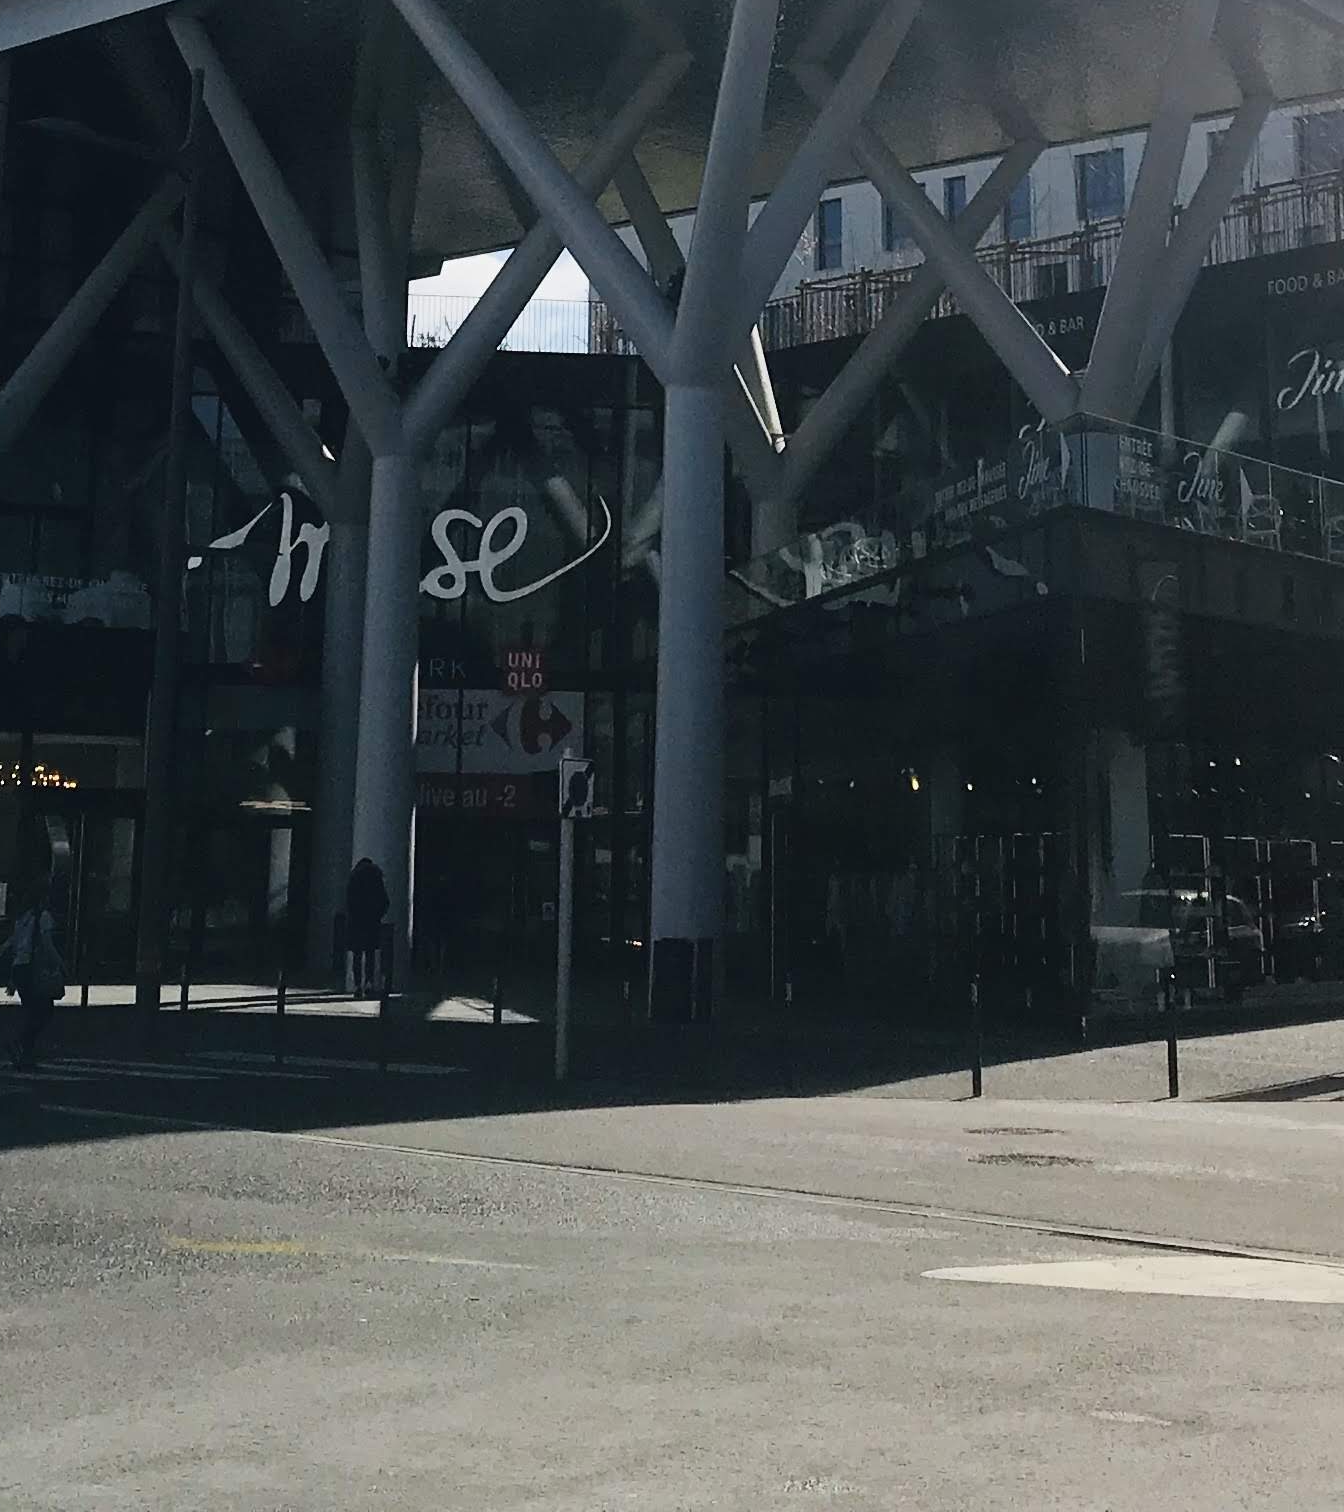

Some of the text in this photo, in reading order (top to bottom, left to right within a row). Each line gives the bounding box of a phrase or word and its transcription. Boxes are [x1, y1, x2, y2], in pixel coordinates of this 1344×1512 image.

[1267, 275, 1309, 297] FOOD
[1312, 272, 1324, 290] &
[1047, 319, 1057, 336] &
[1059, 315, 1085, 335] BAR
[507, 652, 542, 669] UNI
[507, 671, 543, 690] QLO
[462, 789, 488, 808] au
[496, 784, 517, 808] -2
